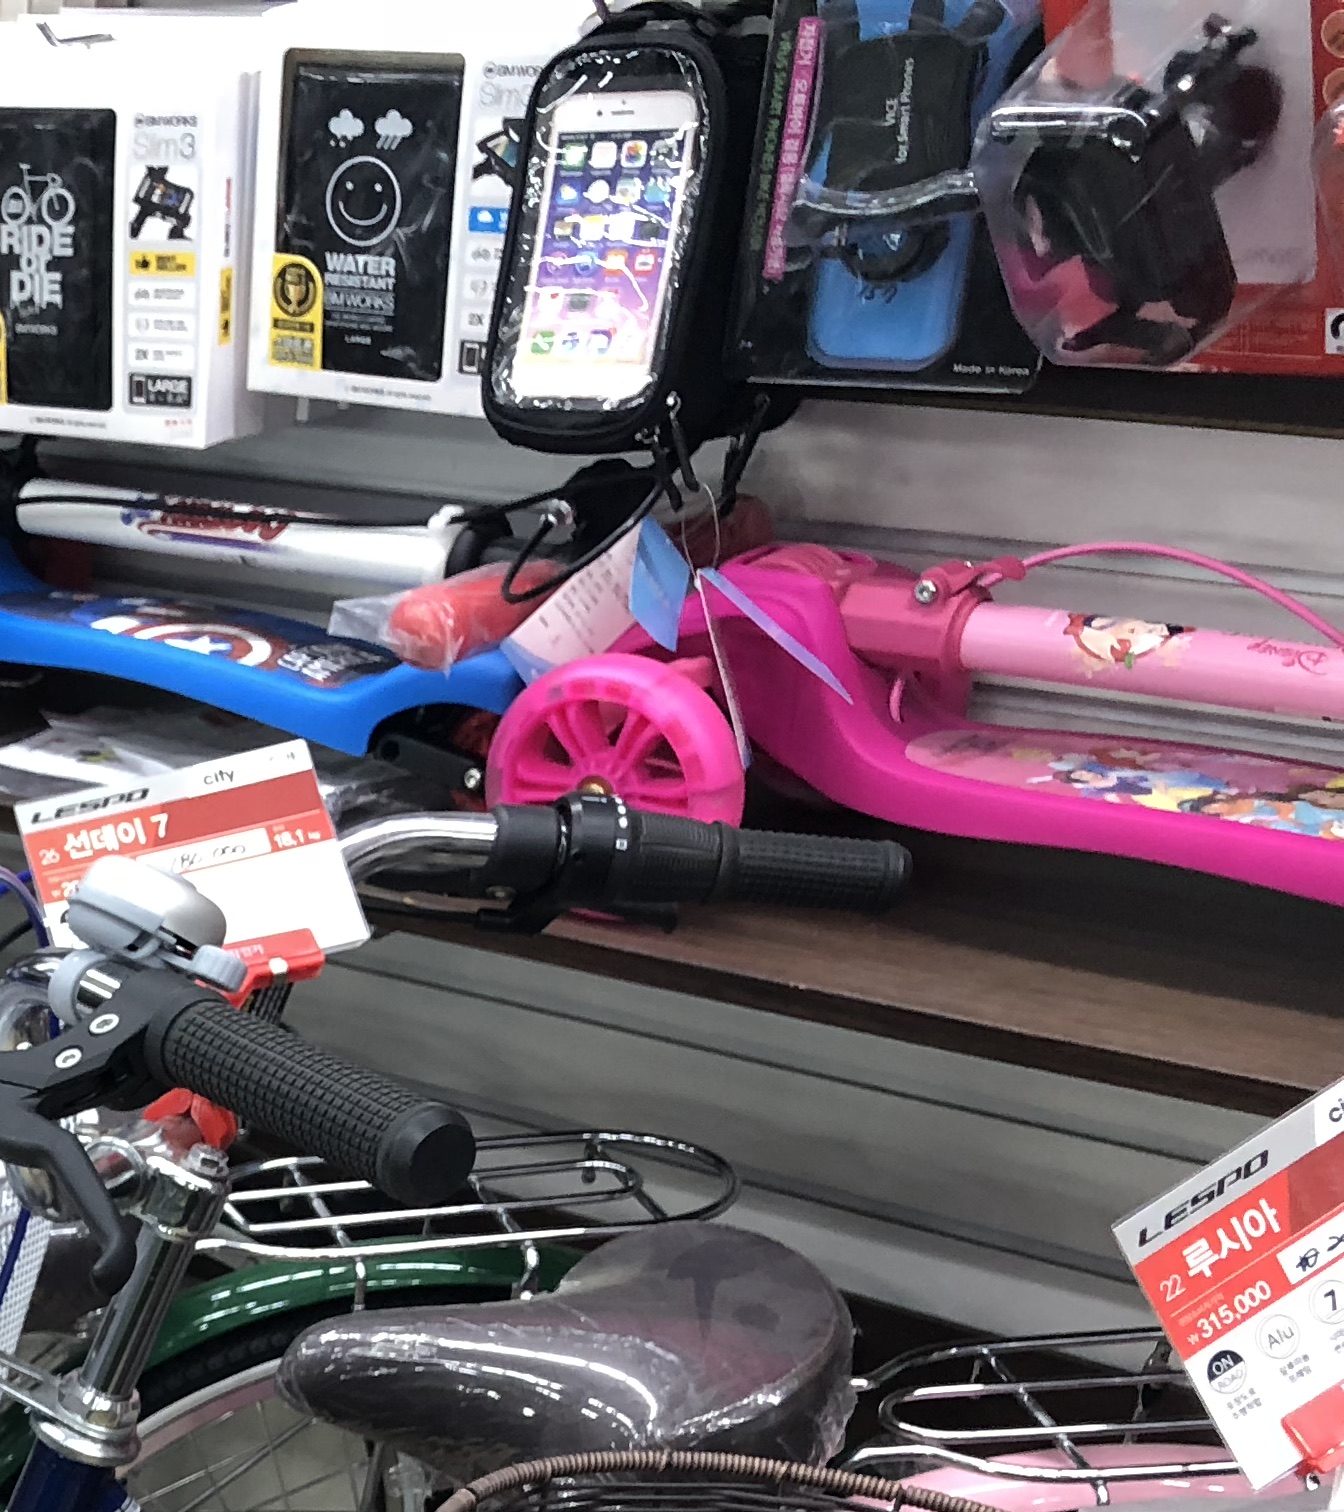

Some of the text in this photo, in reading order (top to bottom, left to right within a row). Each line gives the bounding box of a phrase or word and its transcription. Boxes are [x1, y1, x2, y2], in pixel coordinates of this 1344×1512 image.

[0, 222, 76, 257] RIDE
[324, 251, 397, 278] WATER
[10, 270, 63, 309] DIE
[147, 379, 189, 395] LARGE
[203, 769, 235, 786] city
[30, 787, 150, 825] LESPO
[63, 812, 169, 861] 선데이 7
[39, 848, 61, 866] 26
[1137, 1148, 1270, 1248] LESPO
[1181, 1197, 1282, 1279] 루시아
[1159, 1273, 1187, 1303] 22
[1267, 1326, 1295, 1351] Alu
[1212, 1354, 1235, 1376] ON
